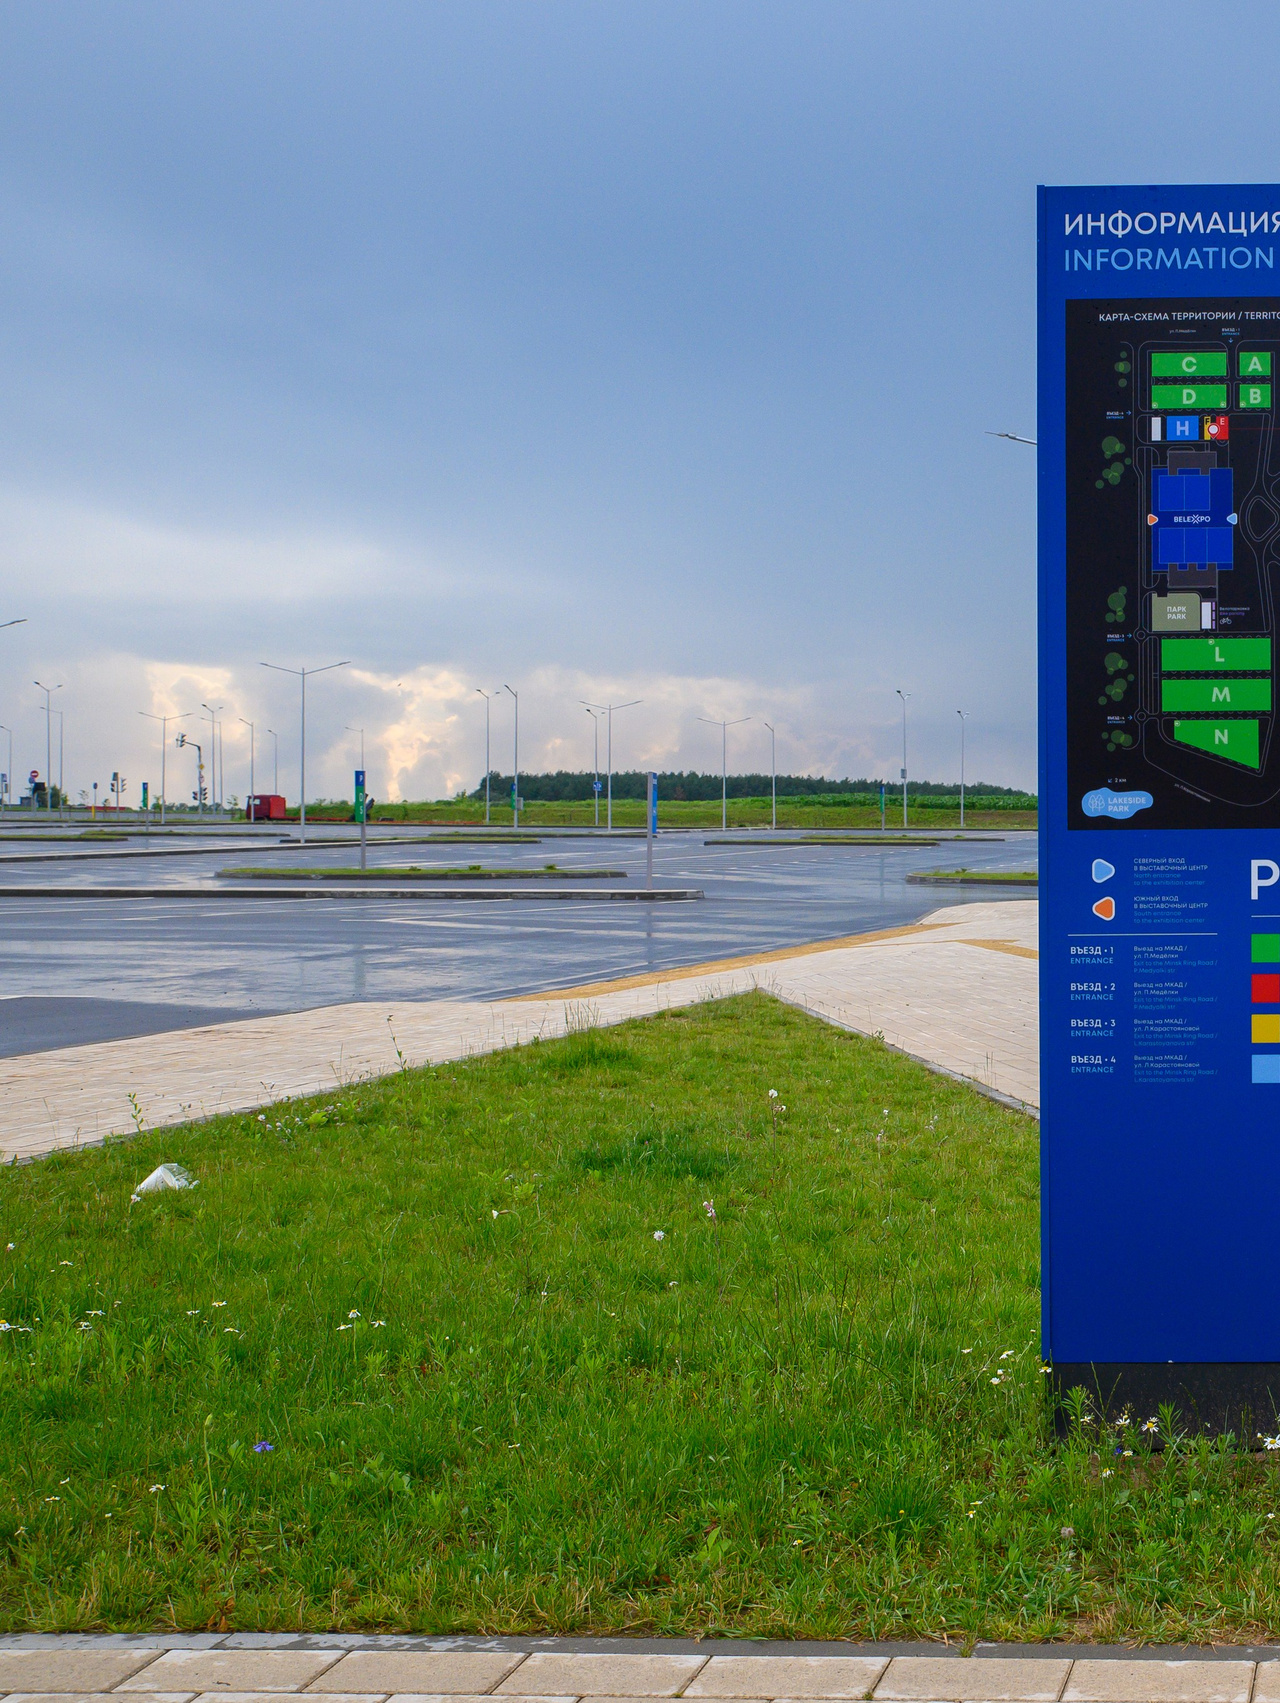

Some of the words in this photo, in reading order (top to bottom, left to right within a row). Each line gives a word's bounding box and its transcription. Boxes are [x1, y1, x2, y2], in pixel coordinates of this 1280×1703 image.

[1065, 247, 1274, 271] INFORMATION
[1099, 312, 1169, 322] КАРТА-СХЕМА
[1171, 312, 1236, 321] ТЕРРИТОРИИ
[1182, 356, 1197, 372] C
[1247, 356, 1262, 372] A
[1182, 389, 1196, 404] D
[1250, 389, 1261, 404] B
[1176, 421, 1189, 436] H
[1174, 514, 1211, 524] BELEXPO
[1215, 647, 1225, 662] L
[1212, 687, 1231, 702] M
[1214, 730, 1228, 744] N
[1251, 859, 1280, 900] P
[1070, 947, 1101, 955] ВЪЕЗД
[1070, 983, 1101, 992] ВЪЕЗД
[1071, 1019, 1102, 1028] ВЪЕЗД
[1071, 1055, 1102, 1064] ВЪЕЗД
